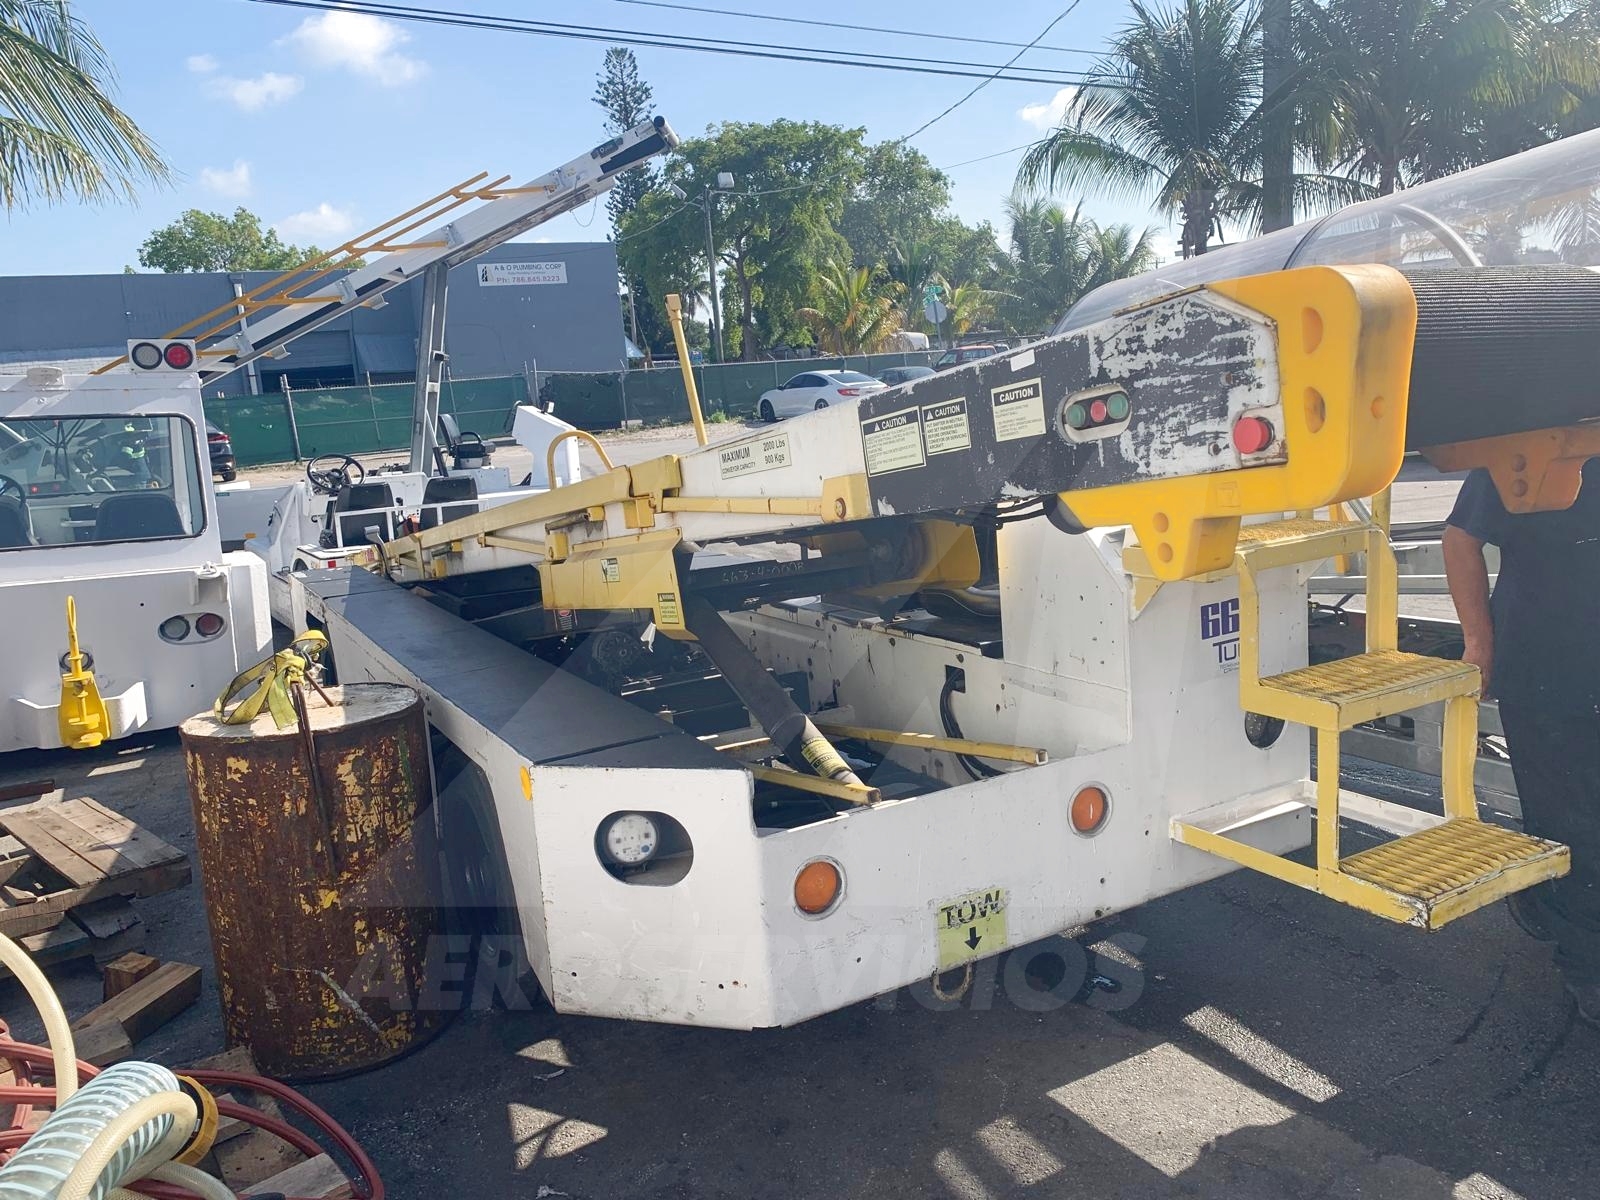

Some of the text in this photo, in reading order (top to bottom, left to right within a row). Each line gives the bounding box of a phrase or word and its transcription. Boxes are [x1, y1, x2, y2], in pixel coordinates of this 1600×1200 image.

[999, 387, 1034, 402] CAUTION
[934, 404, 960, 418] CAUTION
[882, 416, 907, 430] CAUTION
[721, 440, 786, 464] MAXIMUM 2000 Lbs
[722, 452, 785, 474] CONVEYOR CAPACITY 900 Kgs
[1212, 638, 1240, 663] TU
[941, 890, 1000, 928] TOW
